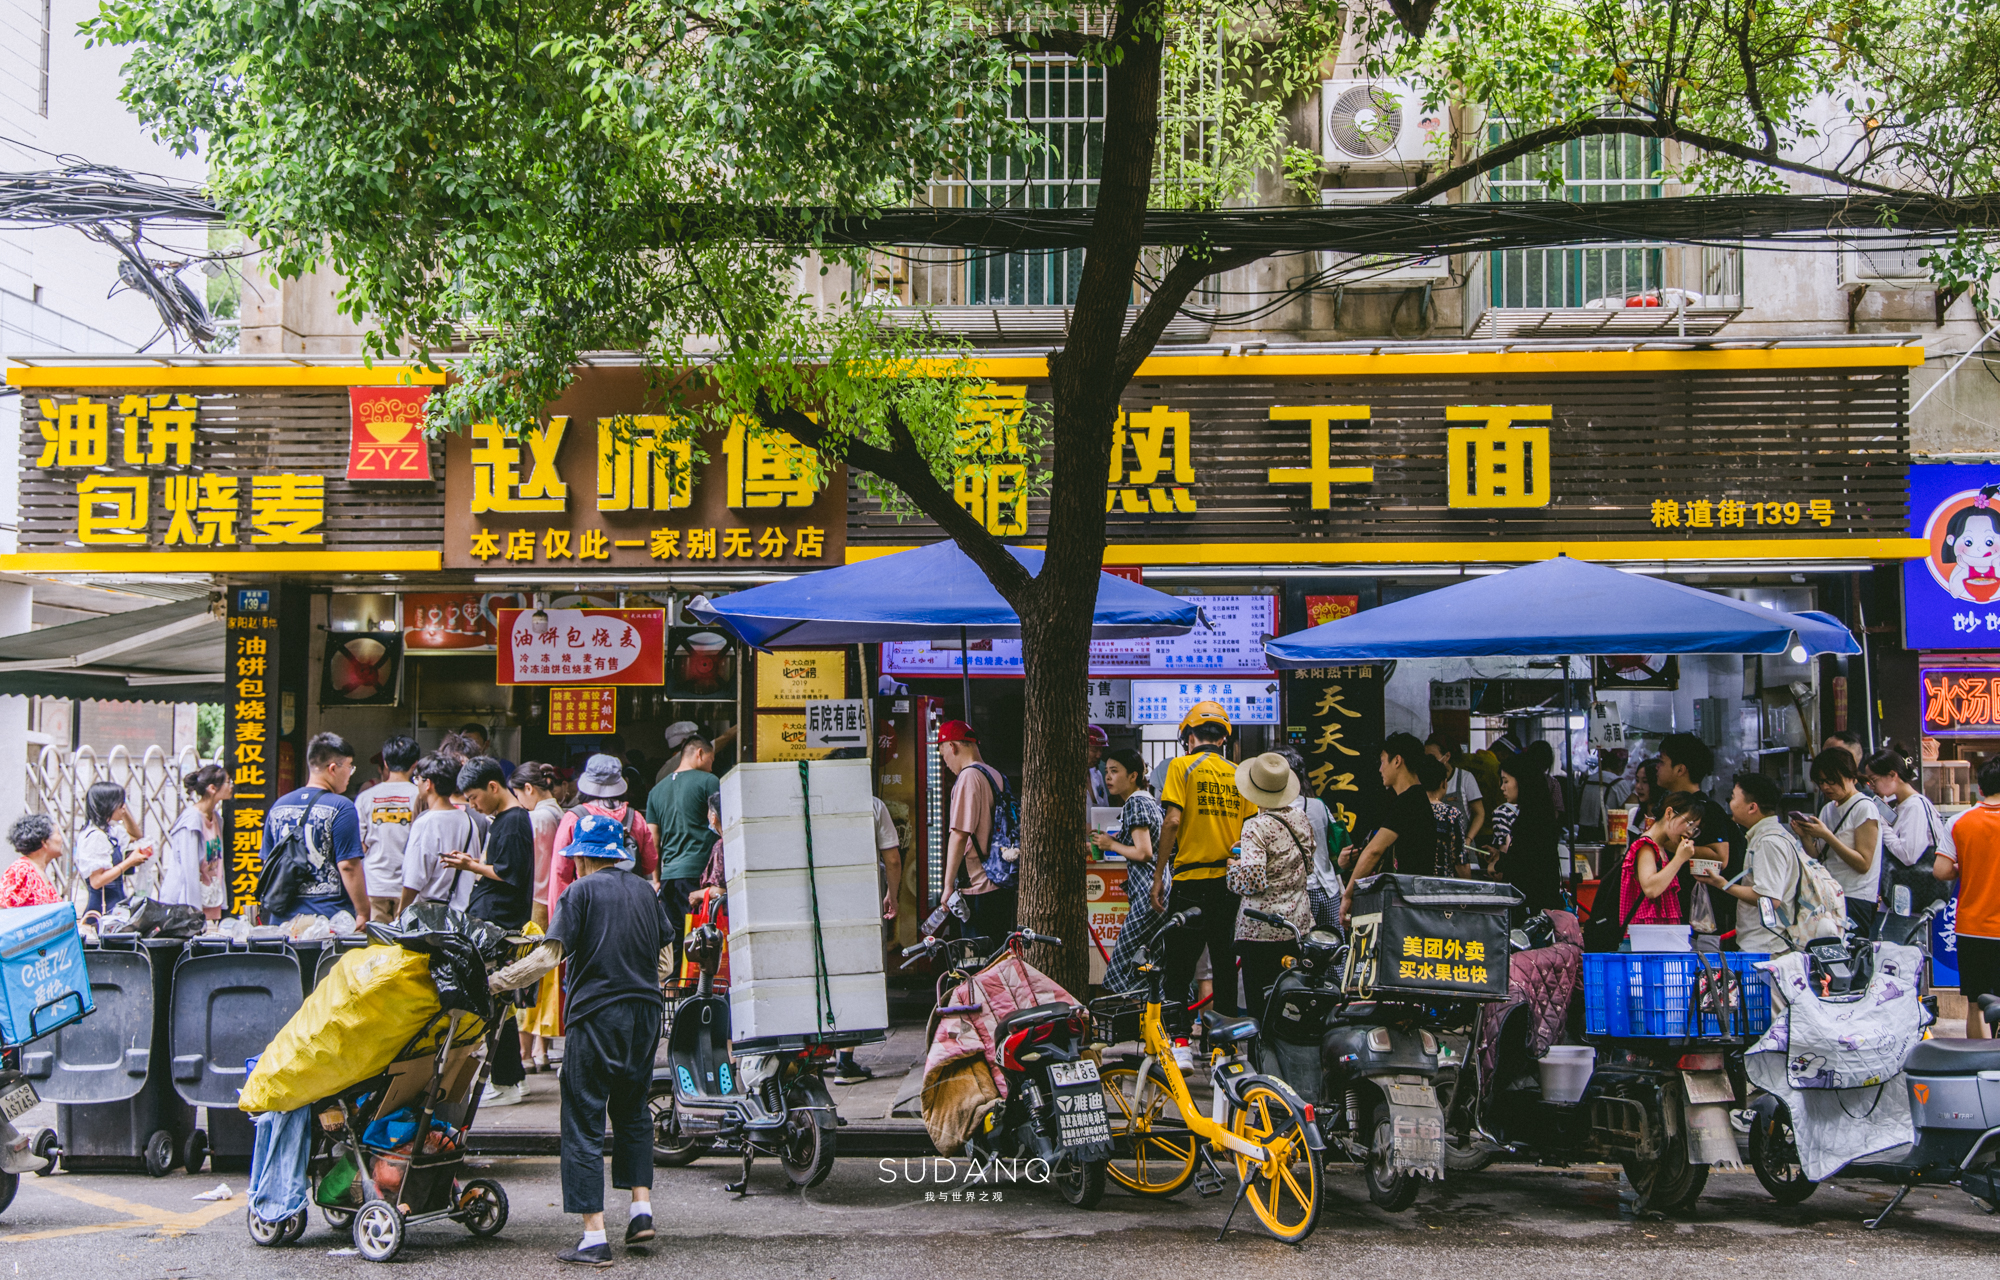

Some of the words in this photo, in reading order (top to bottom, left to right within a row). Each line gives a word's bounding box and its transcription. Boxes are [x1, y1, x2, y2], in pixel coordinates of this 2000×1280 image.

[37, 393, 197, 468] 油饼
[356, 448, 420, 471] ZYZ
[469, 411, 821, 514] 赵师傅
[1106, 404, 1553, 514] 热干面
[76, 473, 326, 545] 包烧麦
[1650, 498, 1836, 529] 粮道街139号
[469, 526, 826, 562] 本店仅此一家别无分店
[244, 598, 259, 610] 139
[514, 625, 637, 649] 油饼包烧麦
[519, 653, 593, 664] 冷冻烧麦
[519, 664, 593, 675] 冷冻油饼包烧麦
[594, 656, 619, 672] 有售
[1179, 683, 1233, 695] 夏季凉品
[1196, 781, 1241, 799] 美团外卖
[1402, 935, 1485, 962] 美团外卖
[1399, 960, 1488, 984] 买水果也快
[1056, 1068, 1097, 1083] 96485
[1073, 1092, 1104, 1112] 雅迪
